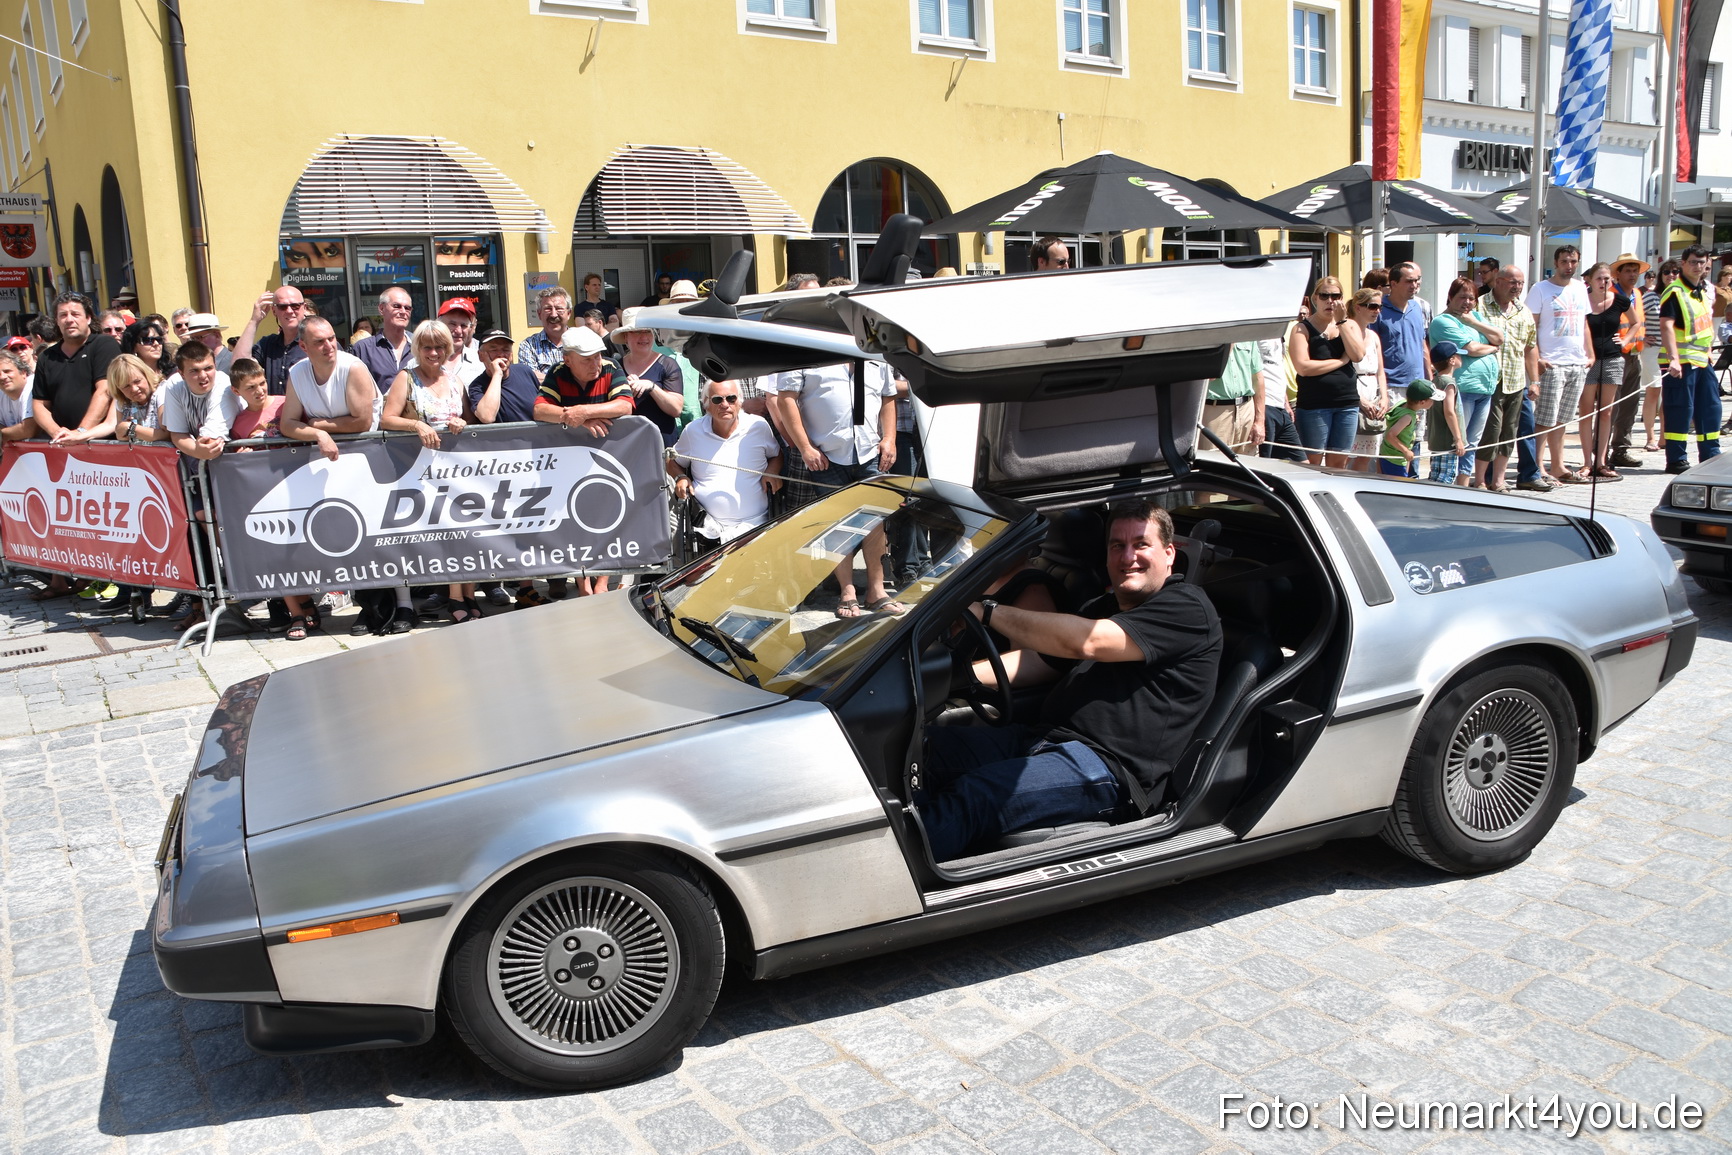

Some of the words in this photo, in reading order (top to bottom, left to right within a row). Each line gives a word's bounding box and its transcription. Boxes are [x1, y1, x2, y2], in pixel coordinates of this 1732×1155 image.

[994, 184, 1066, 223] now
[1140, 180, 1210, 217] now
[1340, 244, 1351, 256] 24
[287, 274, 315, 283] Digitale
[316, 273, 338, 282] Bilder
[438, 283, 497, 292] Bewerbungsbilder
[9, 288, 17, 297] K
[418, 453, 558, 481] Autoklassik
[67, 470, 131, 488] Autoklassik
[55, 488, 130, 529] Dietz
[380, 479, 554, 530] Dietz
[54, 527, 97, 540] BREITENBRUNN
[374, 529, 470, 548] BREITENBRUNN
[10, 542, 180, 581] www.autoklassik-dietz.de
[255, 537, 641, 590] www.autoklassik-dietz.de
